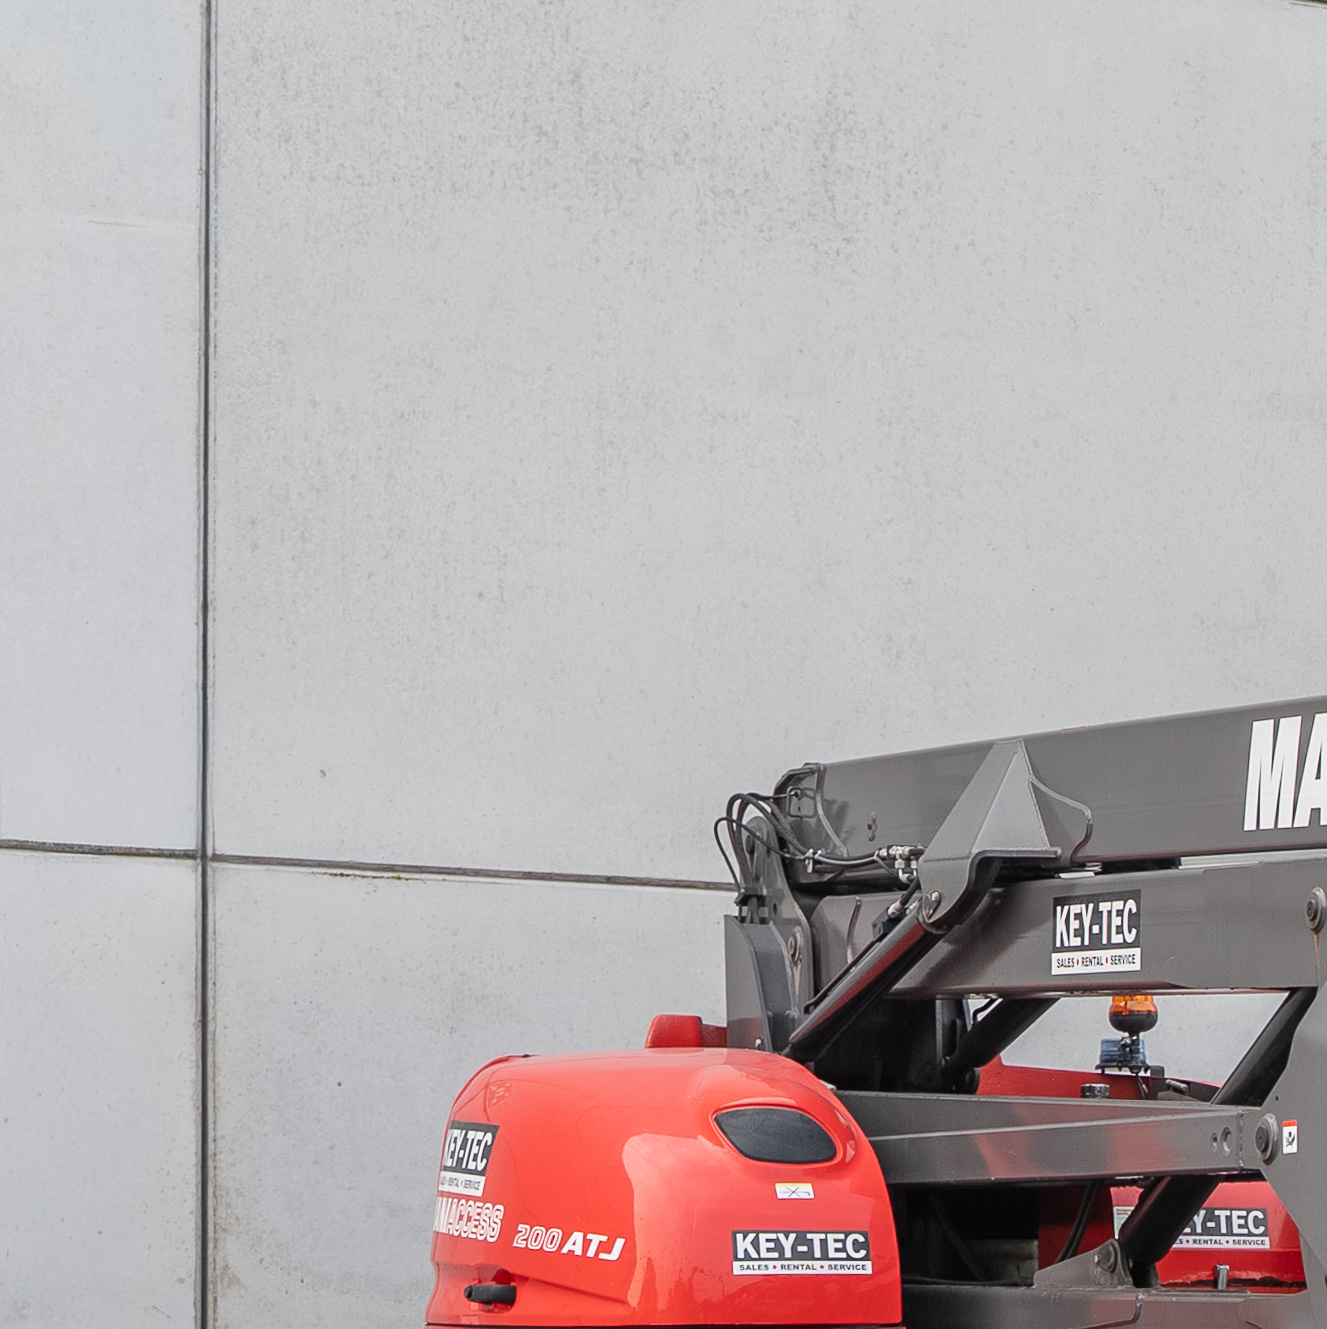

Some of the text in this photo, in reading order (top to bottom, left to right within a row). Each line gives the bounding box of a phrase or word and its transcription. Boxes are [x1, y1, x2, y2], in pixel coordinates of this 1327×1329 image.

[1055, 899, 1138, 948] KEY-TEC
[1056, 953, 1136, 969] SALES RENTAL SERVICE
[444, 1128, 493, 1172] KEY-TEC
[1183, 1209, 1266, 1235] Y-TEC
[735, 1232, 868, 1259] KEY-TEC
